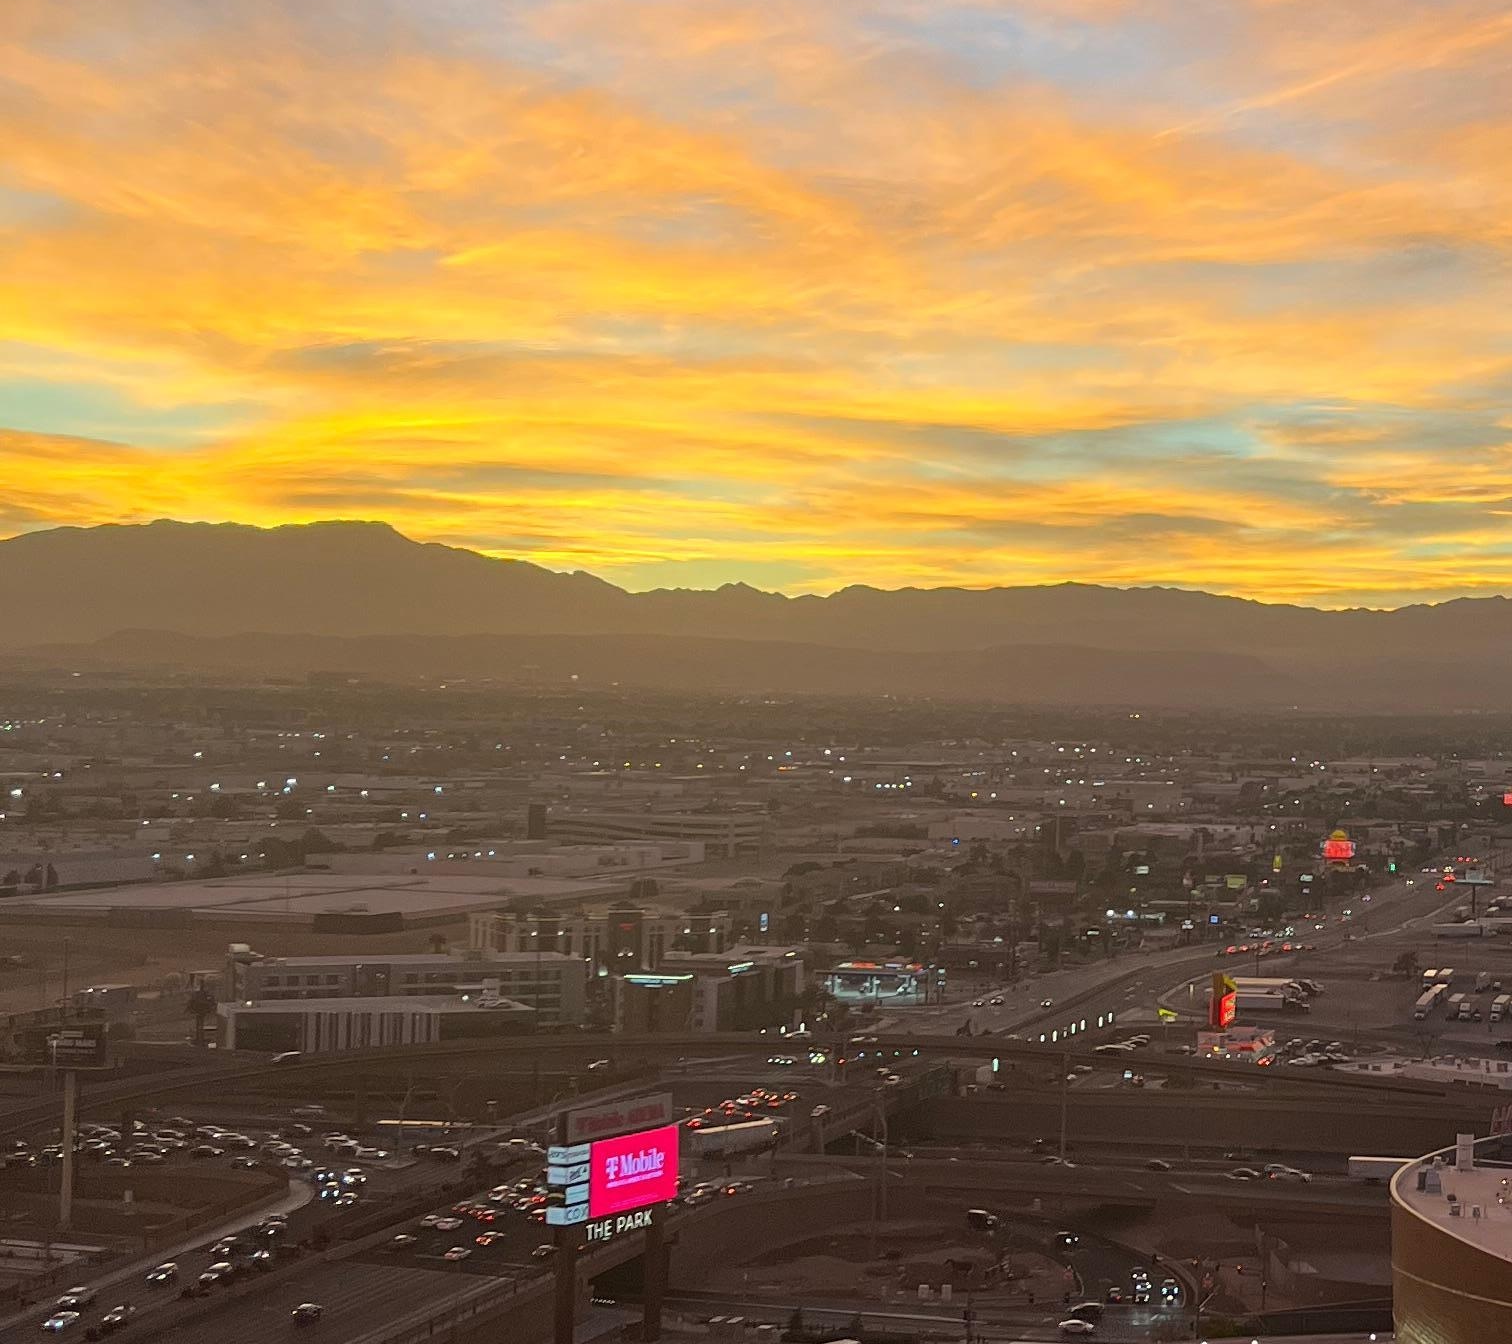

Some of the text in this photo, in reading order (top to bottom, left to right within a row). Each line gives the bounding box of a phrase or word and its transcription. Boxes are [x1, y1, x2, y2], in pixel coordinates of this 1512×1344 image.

[619, 1148, 665, 1177] Mobile
[586, 1209, 653, 1241] THE PARK
